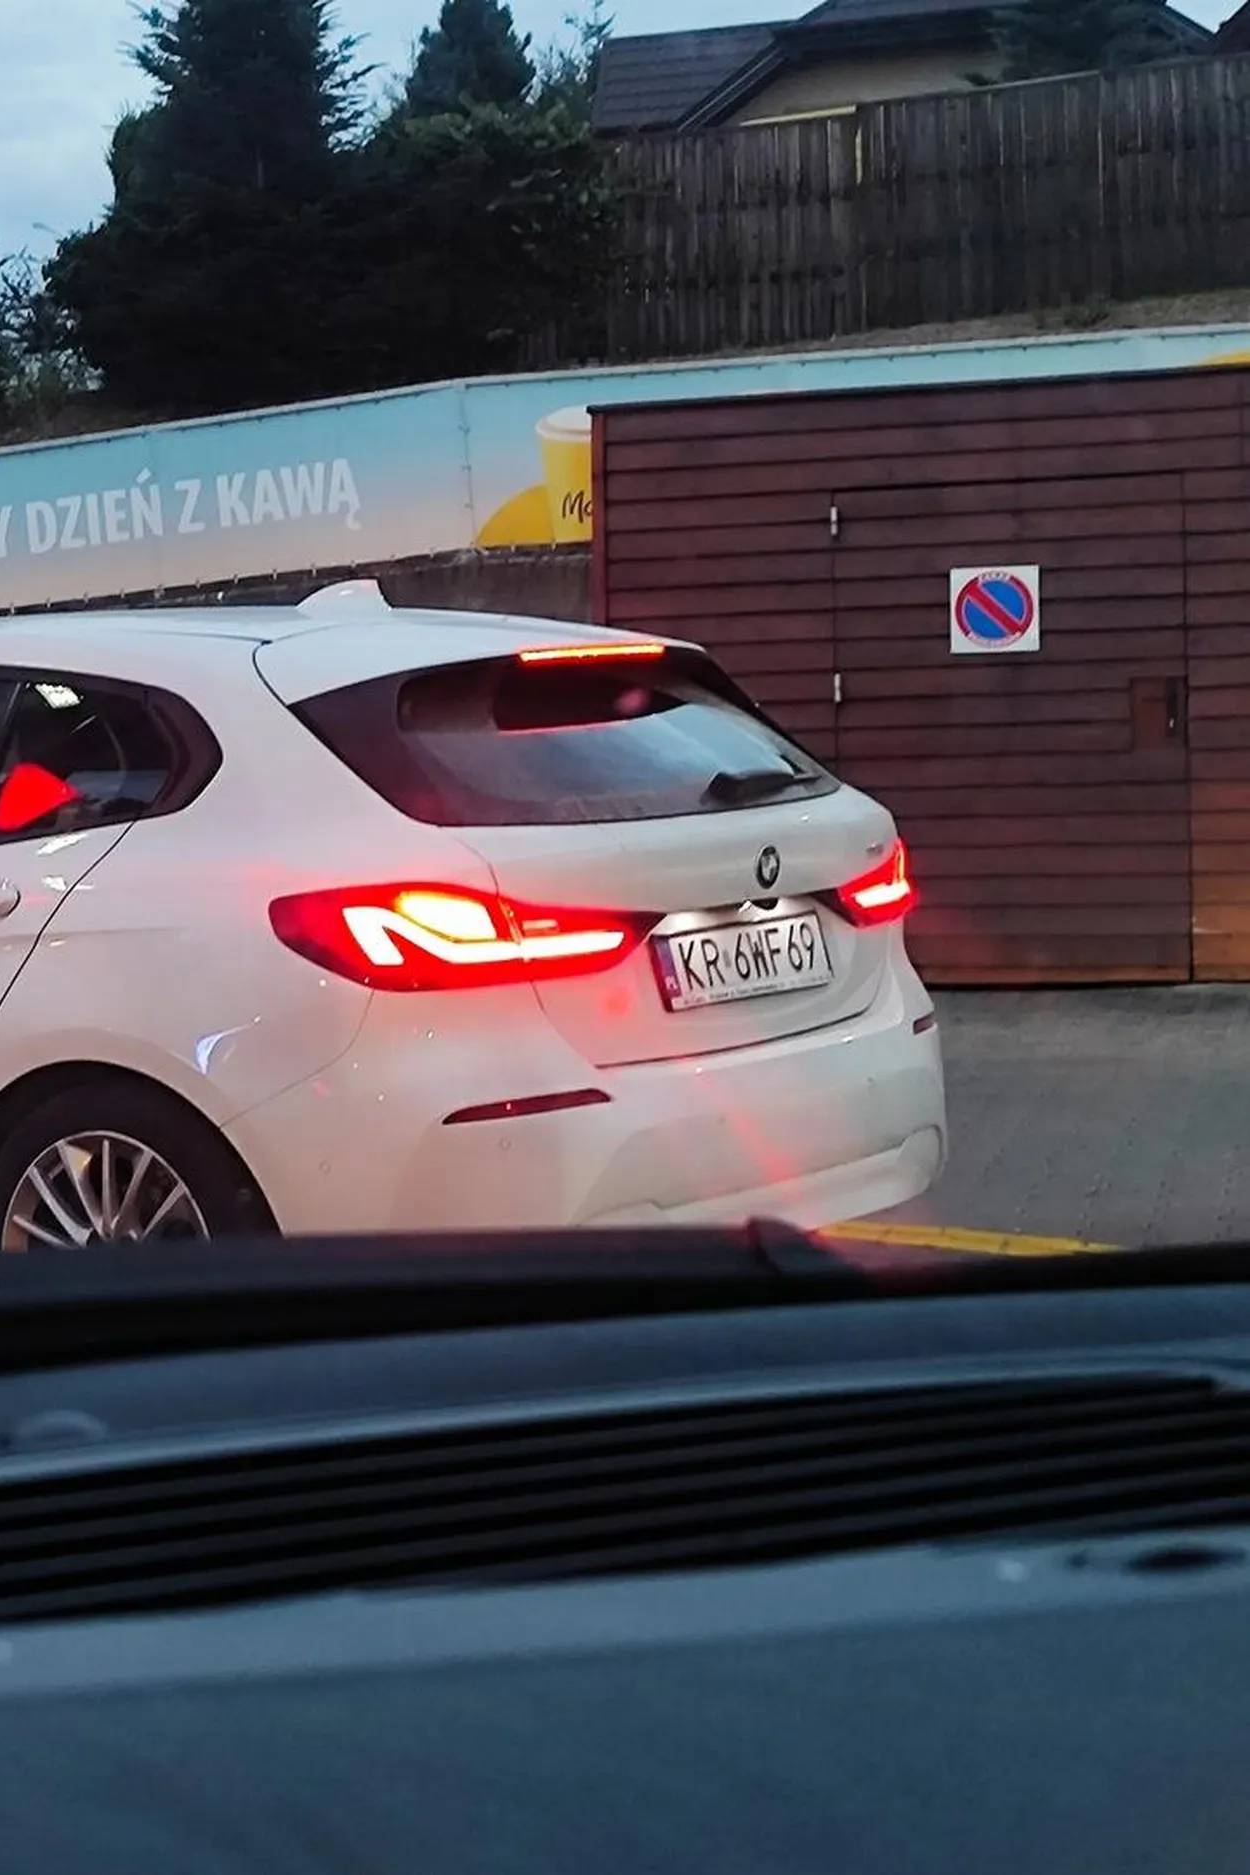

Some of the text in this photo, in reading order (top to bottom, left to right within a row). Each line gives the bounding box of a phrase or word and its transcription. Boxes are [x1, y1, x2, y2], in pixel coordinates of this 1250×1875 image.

[25, 467, 164, 555] DZIEŃ
[174, 478, 206, 534] Z
[215, 457, 362, 532] KAWĄ
[678, 939, 726, 990] KR
[734, 921, 815, 981] 6WF69
